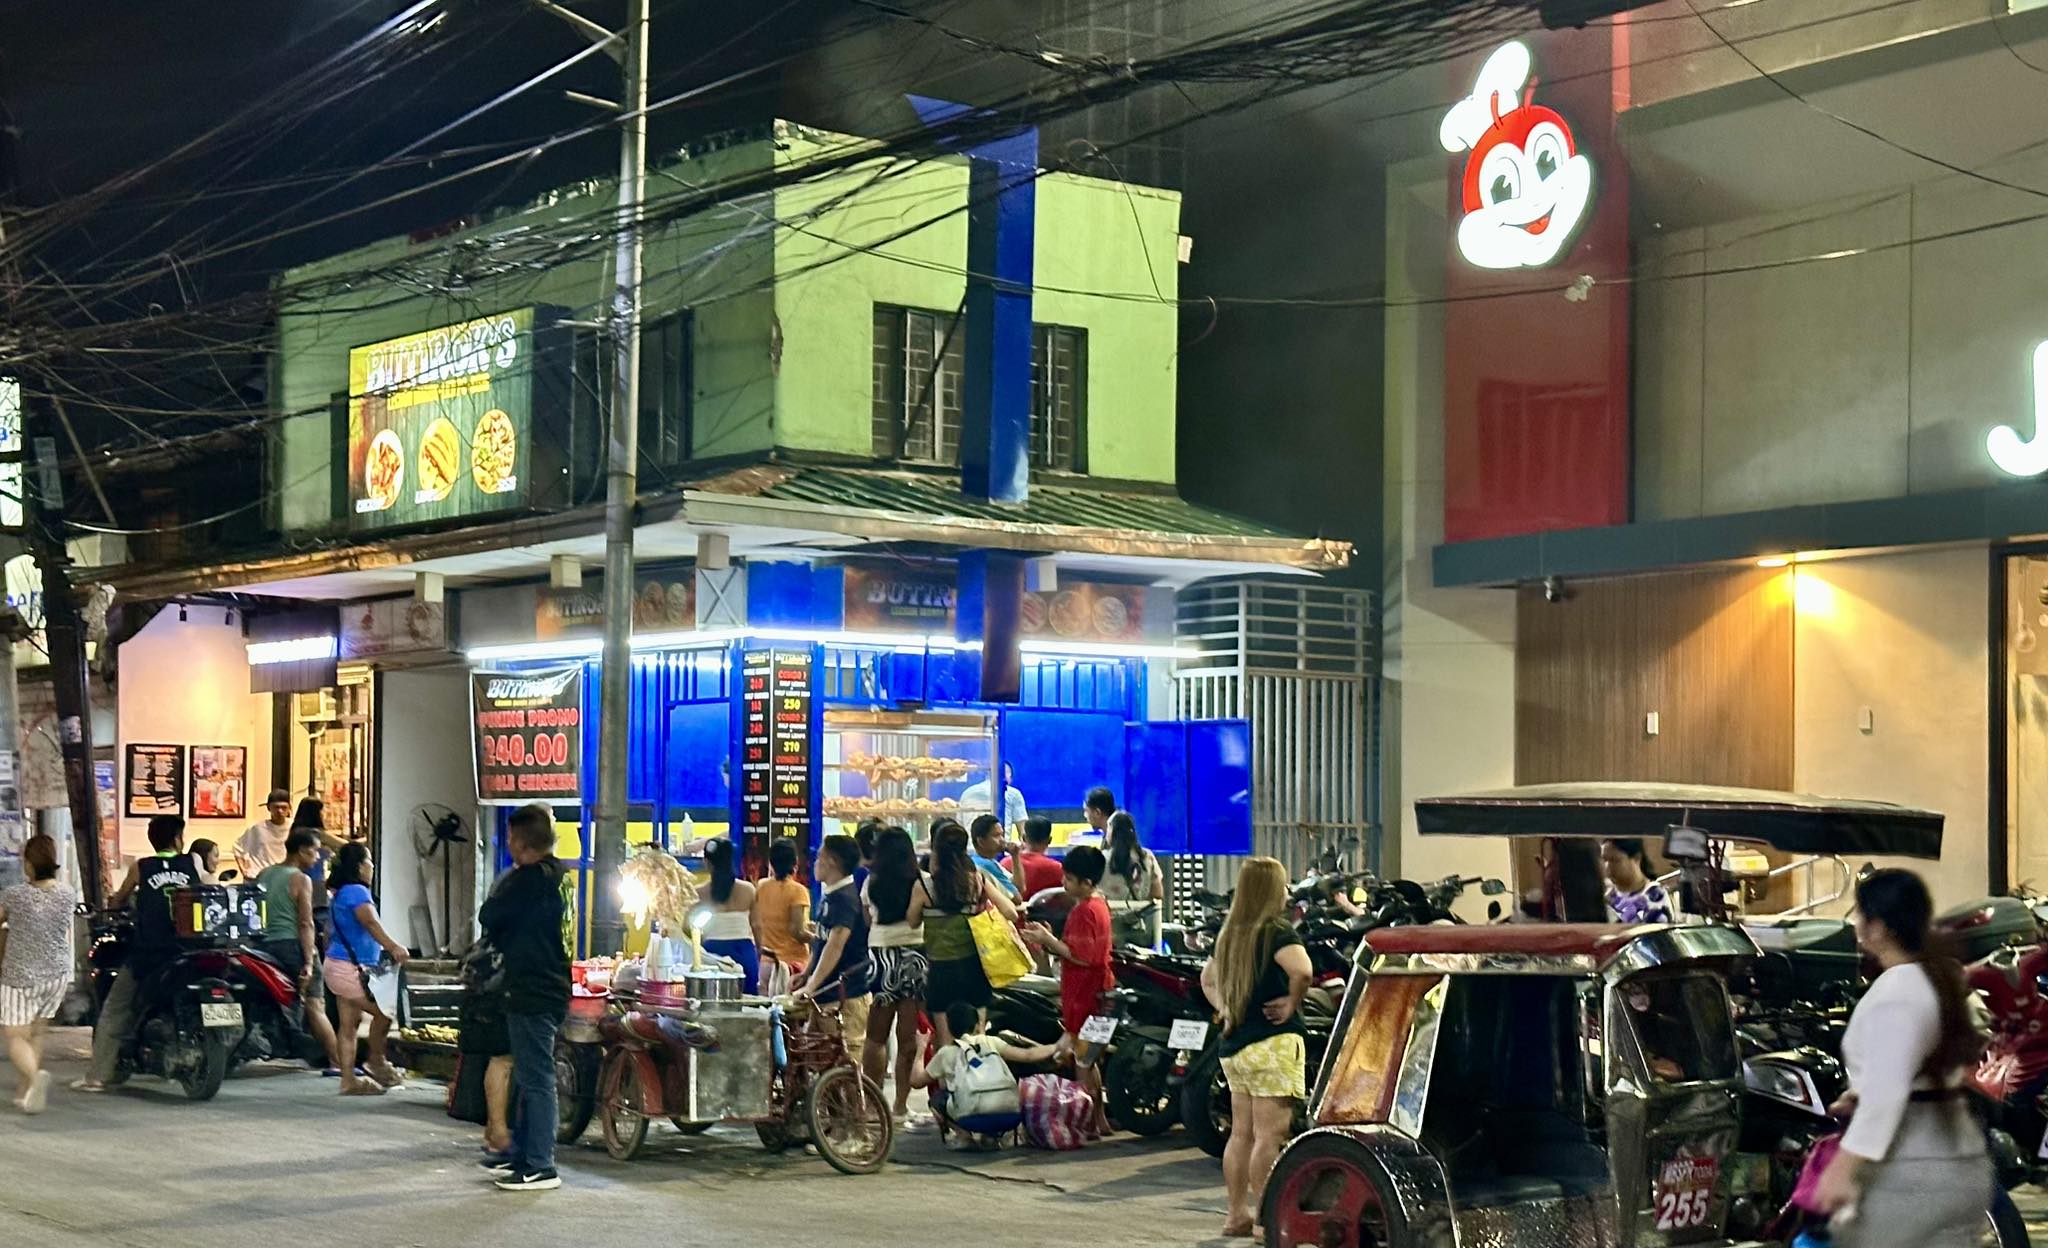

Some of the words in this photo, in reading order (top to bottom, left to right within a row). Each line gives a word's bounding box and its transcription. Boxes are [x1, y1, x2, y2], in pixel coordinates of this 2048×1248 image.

[528, 707, 579, 727] PROMO
[483, 732, 568, 767] 240.00
[784, 742, 800, 752] 370
[1656, 1188, 1710, 1231] 255
